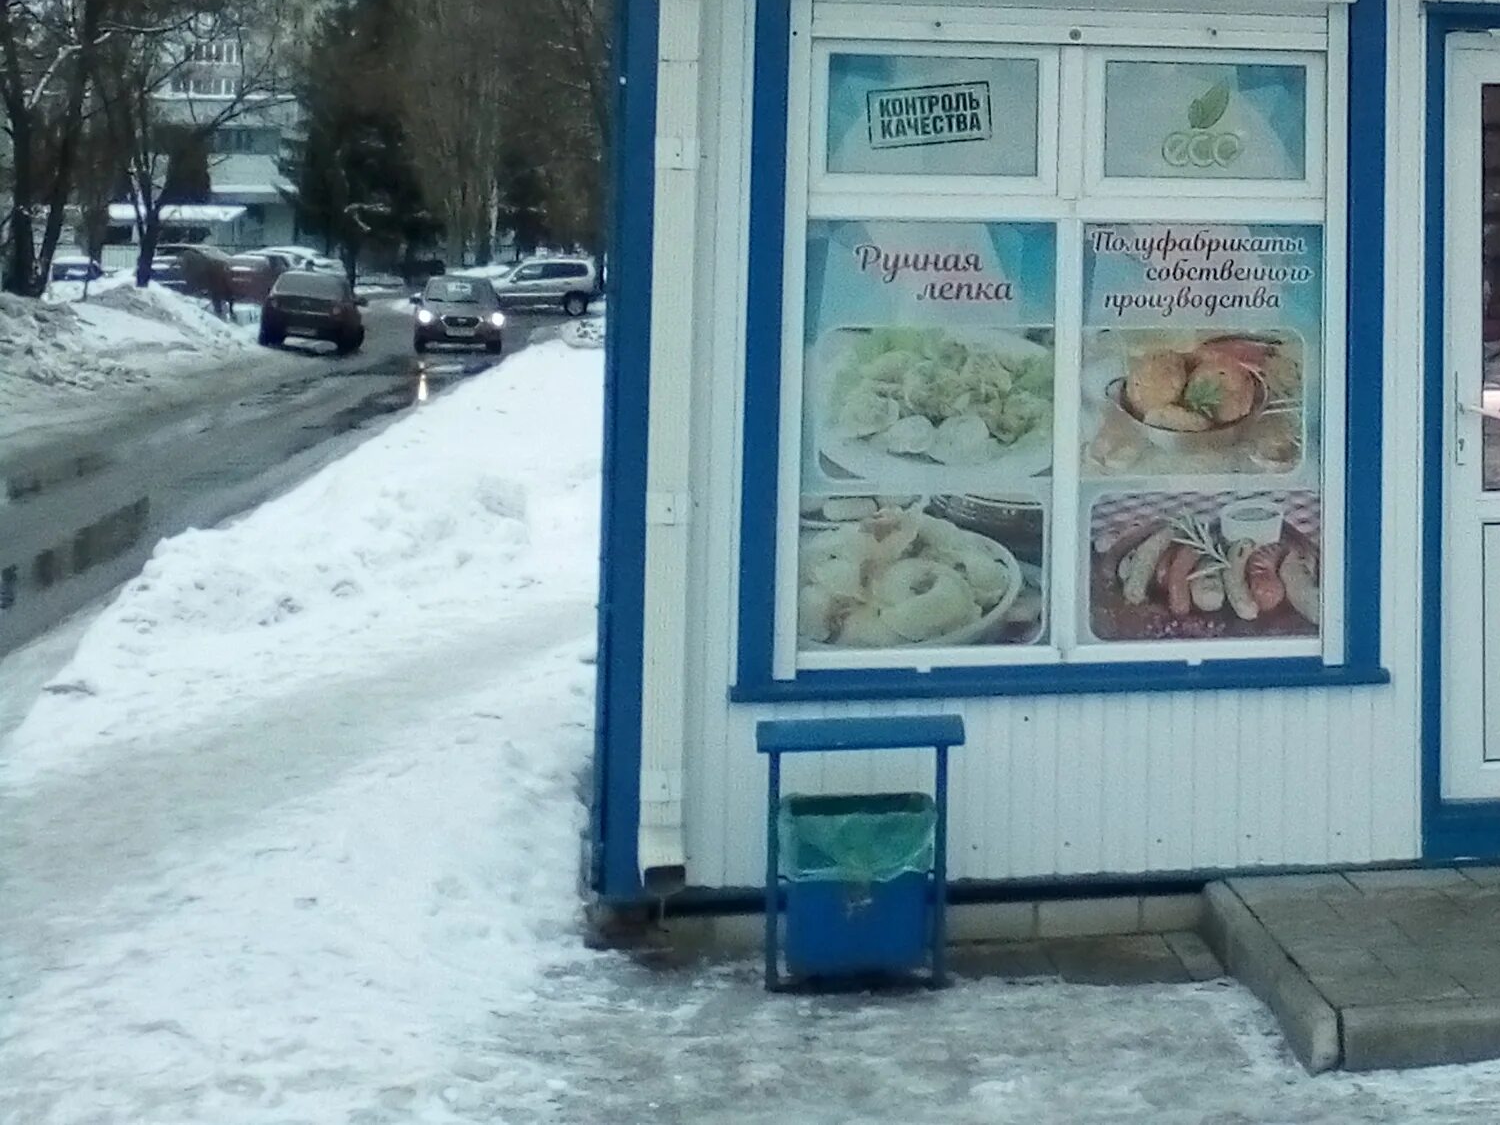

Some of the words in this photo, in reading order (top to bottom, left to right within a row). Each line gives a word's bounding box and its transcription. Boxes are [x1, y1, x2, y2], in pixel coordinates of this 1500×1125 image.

[880, 91, 981, 118] КОНТРОЛЬ
[880, 112, 982, 140] КАЧЕСТВА
[1091, 229, 1306, 260] Полуфабрикаты
[855, 244, 984, 283] Ручная
[1145, 258, 1312, 282] собственного
[915, 281, 1014, 301] лепка
[1104, 285, 1281, 317] производства
